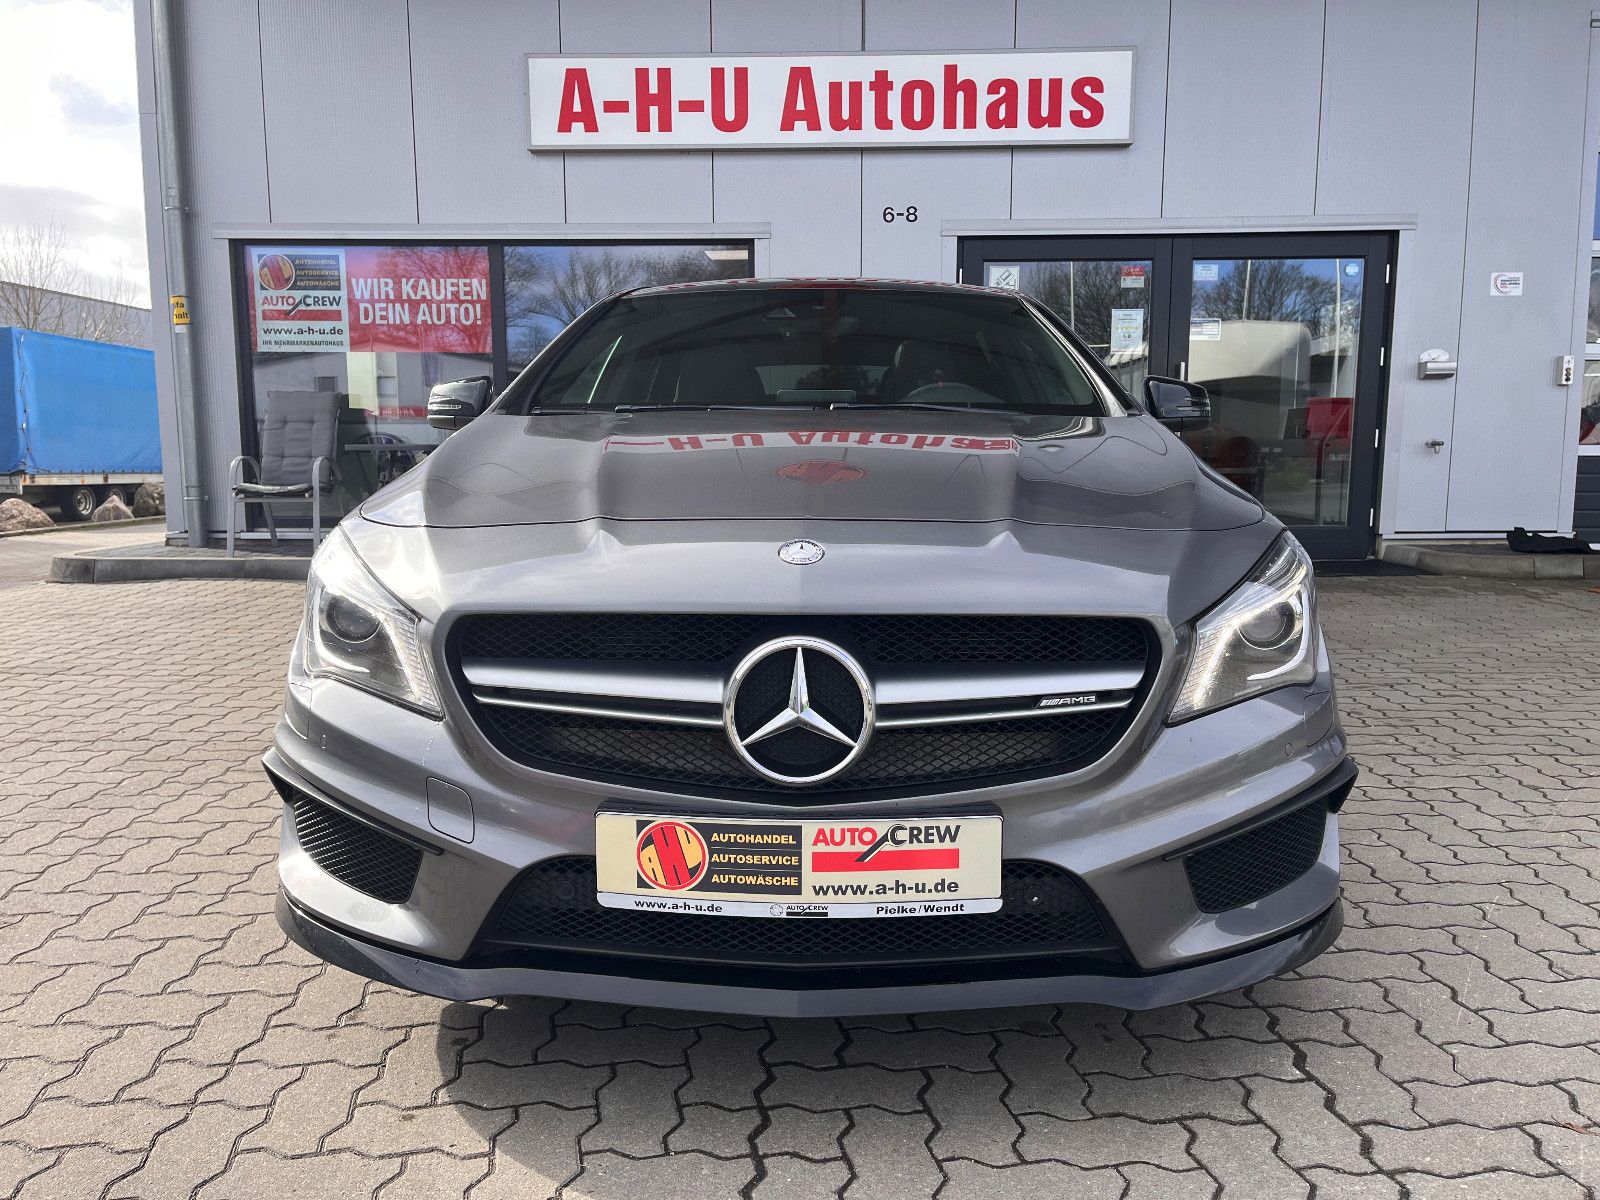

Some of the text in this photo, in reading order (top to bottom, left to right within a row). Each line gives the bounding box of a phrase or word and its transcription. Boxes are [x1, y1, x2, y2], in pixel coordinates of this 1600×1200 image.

[556, 64, 1105, 133] A-H-U Autohaus
[882, 205, 918, 224] 6-8
[351, 277, 487, 300] WIR KAUFEN
[261, 295, 342, 307] AUTO CREW
[359, 302, 482, 325] DEIN AUTO!
[262, 326, 344, 336] www.a-h-u.de
[710, 832, 797, 844] AUTOHANDEL
[811, 824, 962, 847] AUTO CREW
[710, 853, 799, 865] AUTOSERVICE
[710, 874, 799, 886] AUTOWÄSCHE
[811, 878, 960, 897] www.a-h-u.de
[634, 900, 723, 913] www.a-h-u.de
